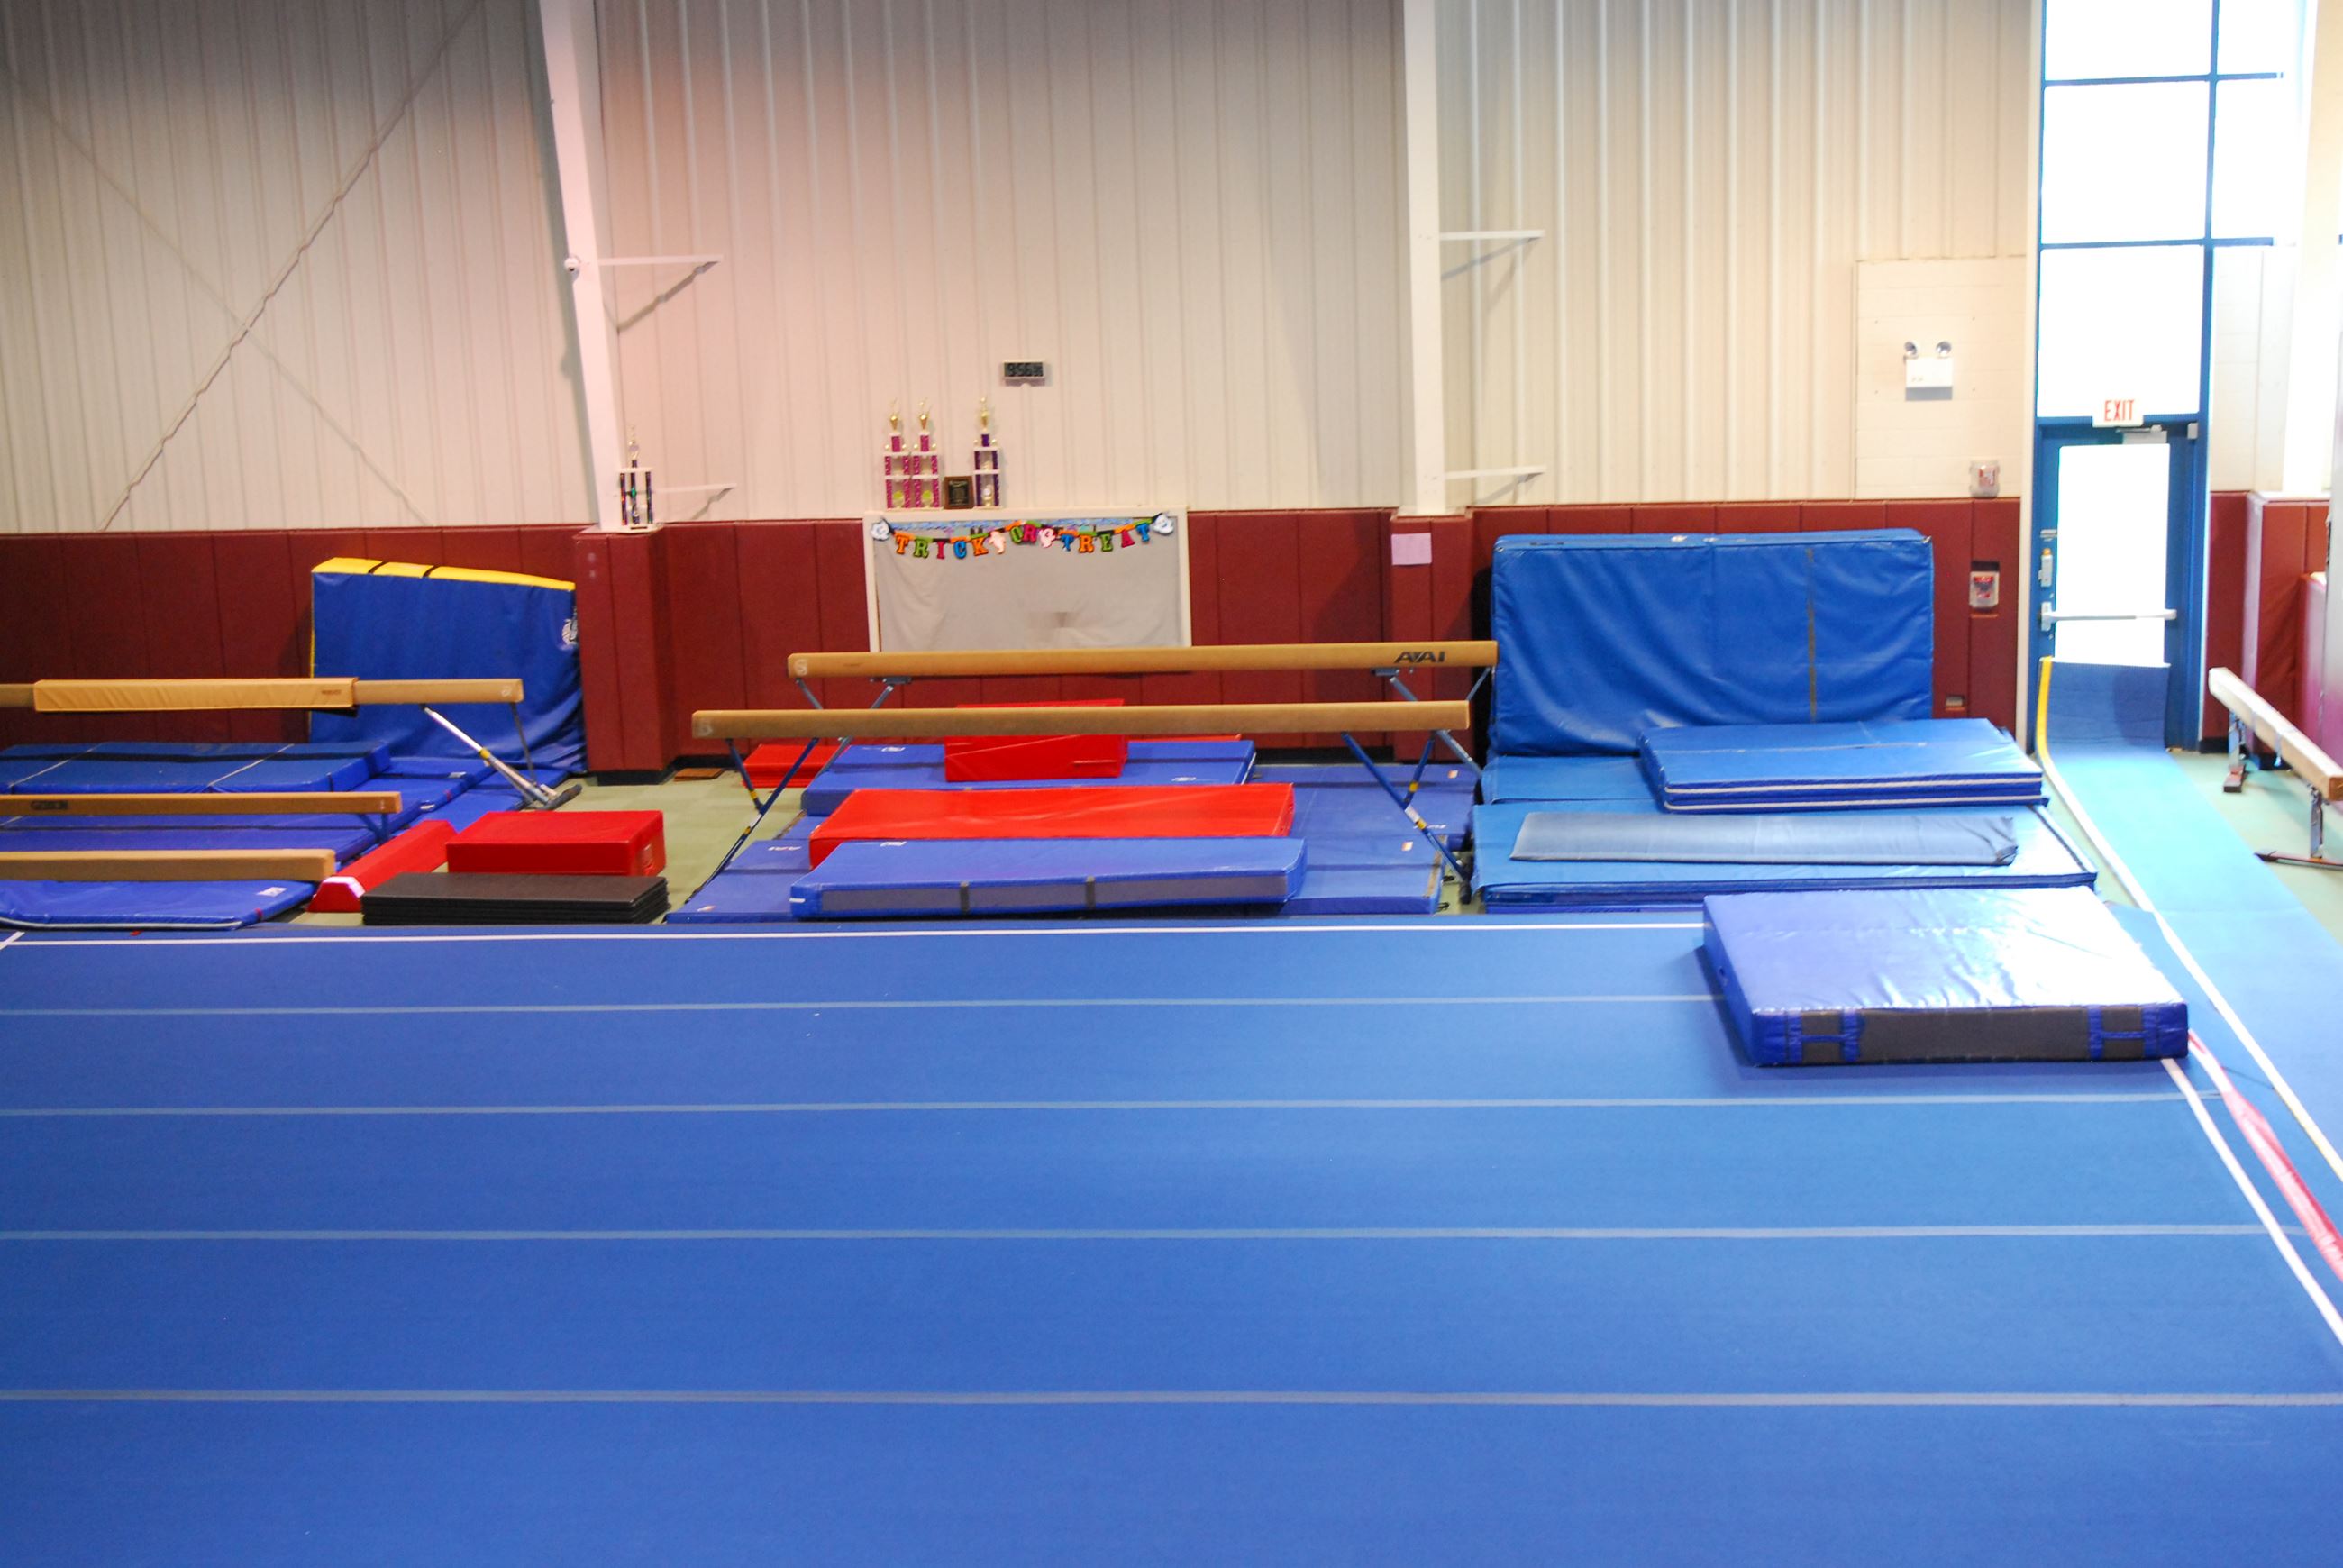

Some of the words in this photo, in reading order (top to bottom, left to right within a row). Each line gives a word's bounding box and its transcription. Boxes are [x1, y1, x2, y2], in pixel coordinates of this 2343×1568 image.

[2104, 399, 2134, 421] EXIT
[895, 533, 989, 559] TRICK
[1009, 524, 1036, 544] OR
[1060, 523, 1150, 552] TREAT
